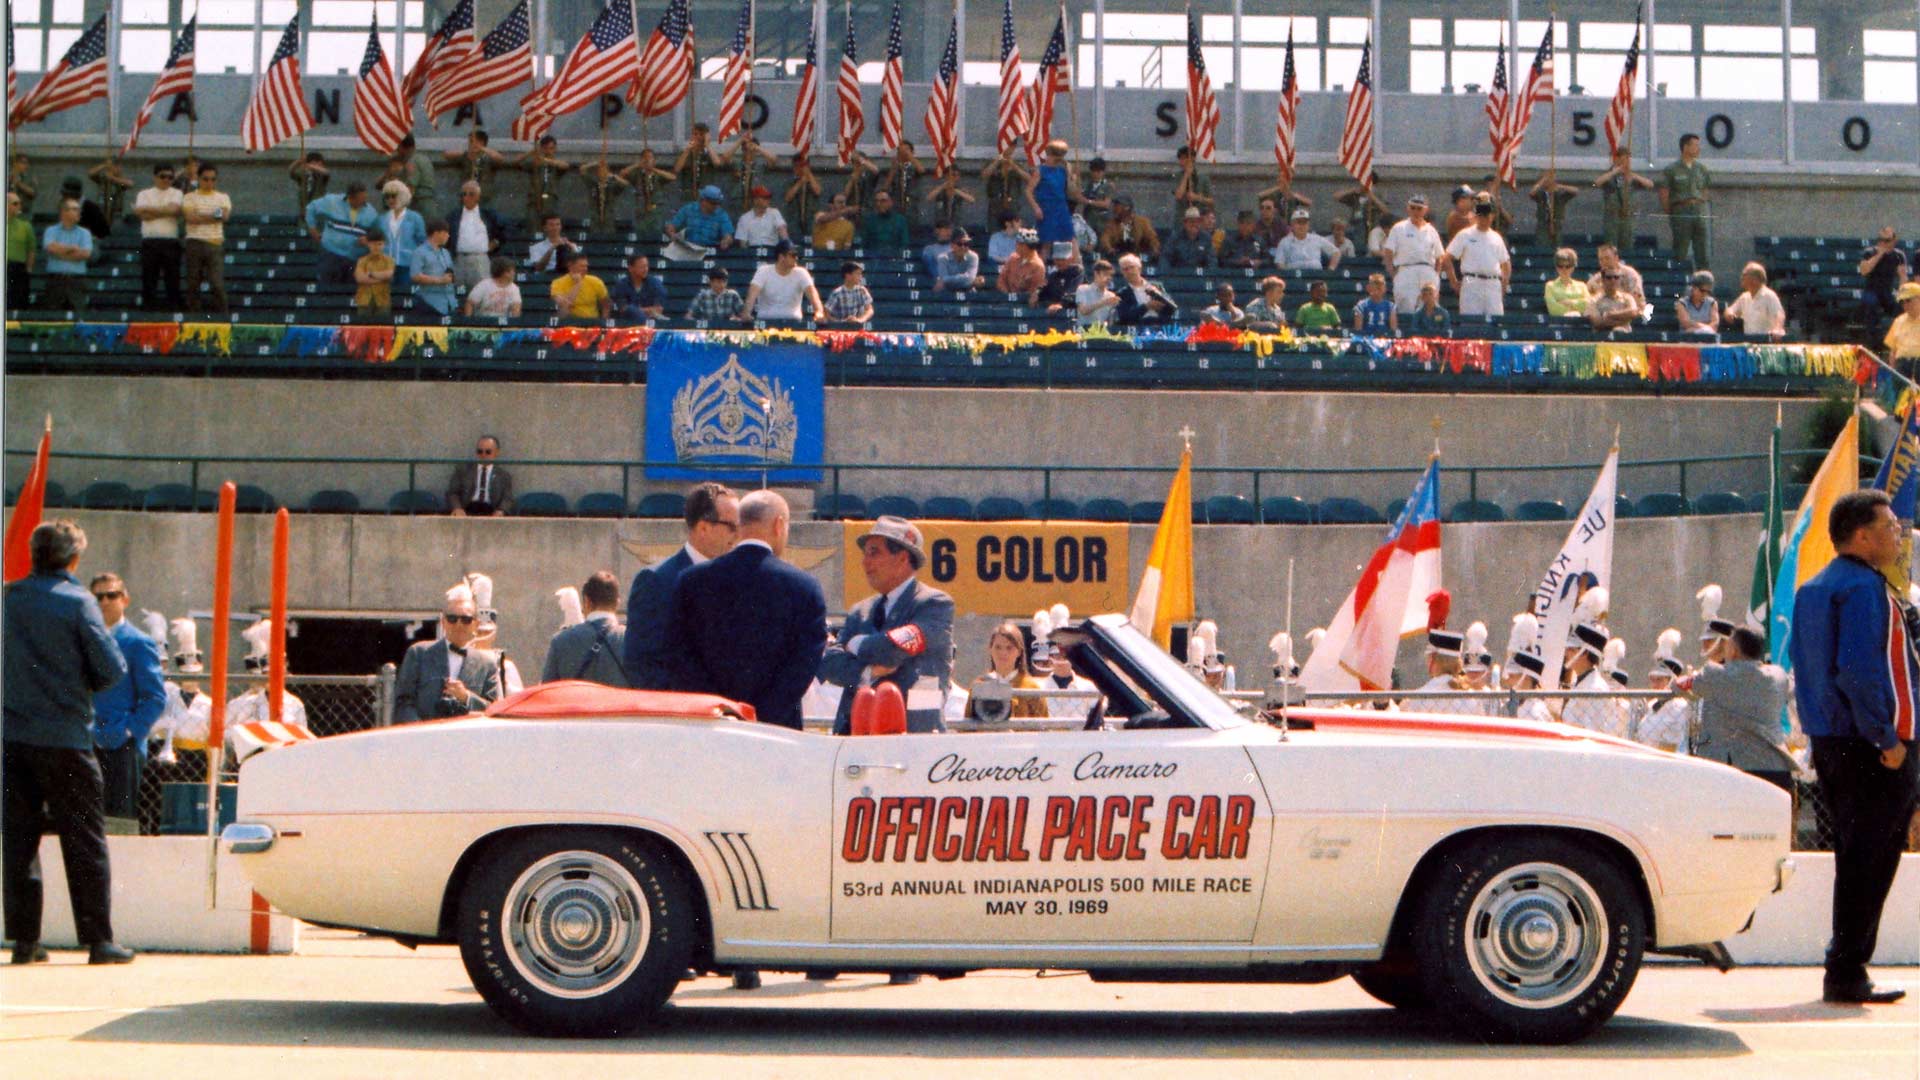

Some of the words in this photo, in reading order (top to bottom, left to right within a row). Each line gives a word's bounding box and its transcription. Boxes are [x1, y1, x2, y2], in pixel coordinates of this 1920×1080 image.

[285, 314, 295, 324] 12
[340, 314, 350, 324] 13
[394, 315, 404, 325] 14
[549, 317, 559, 327] 17
[537, 350, 547, 360] 17
[922, 355, 932, 366] 17
[1086, 357, 1096, 367] 14
[1199, 359, 1209, 369] 12
[931, 538, 957, 583] 6
[976, 535, 1107, 583] COLOR
[928, 752, 1055, 784] Chevrolet
[1074, 751, 1178, 781] Camaro
[842, 795, 1030, 863] OFFICIAL
[1039, 795, 1154, 862] PACE
[1160, 795, 1256, 861] CAR
[843, 881, 884, 897] 53rd
[891, 880, 966, 896] ANNUAL
[973, 878, 1104, 895] INDIANAPOLIS
[1110, 877, 1144, 893] 500
[1152, 878, 1196, 893] MILE
[1203, 878, 1252, 894] RACE
[985, 900, 1028, 916] MAY
[1068, 899, 1109, 916] 1969
